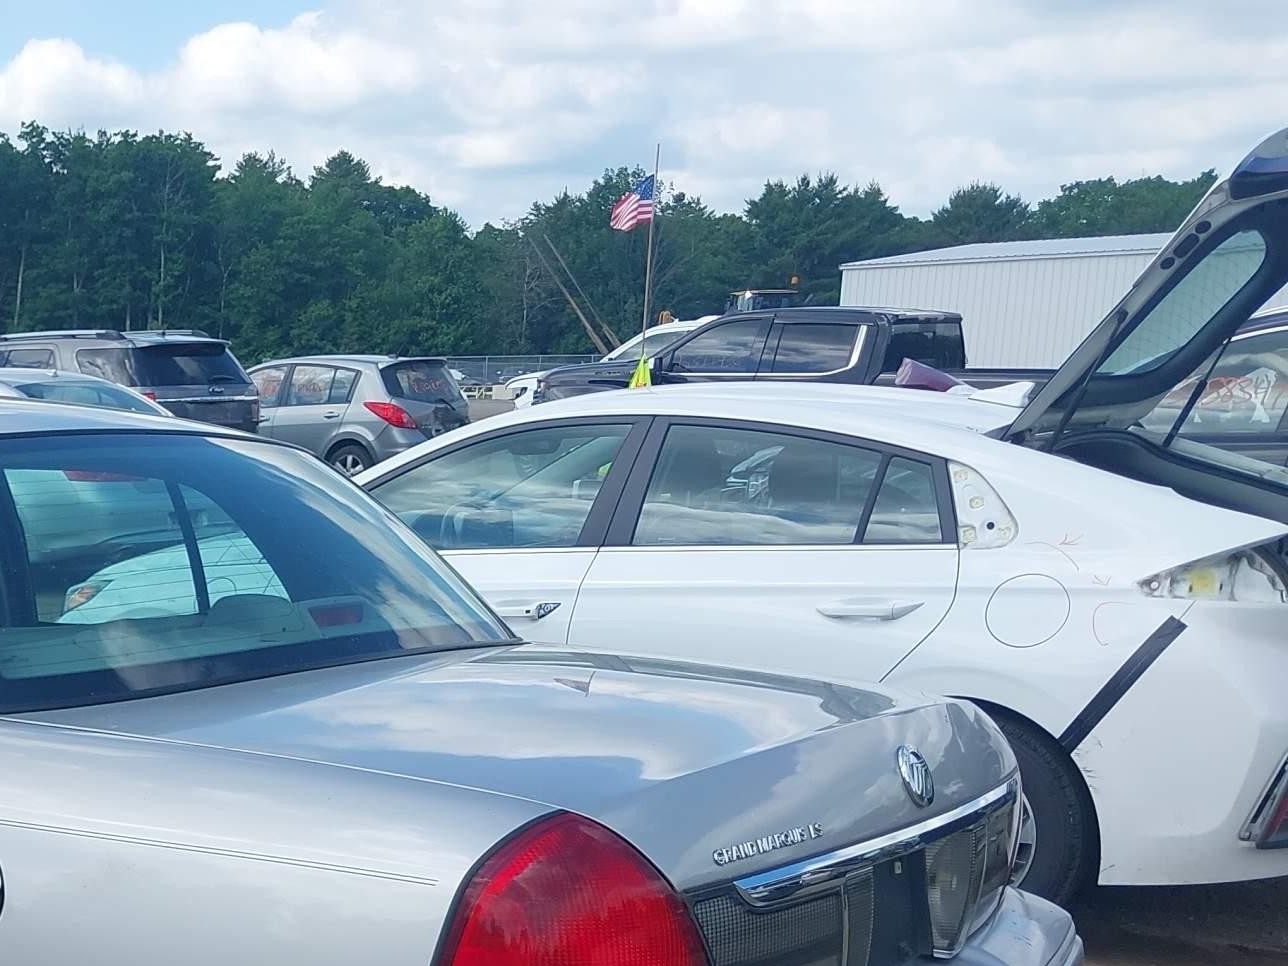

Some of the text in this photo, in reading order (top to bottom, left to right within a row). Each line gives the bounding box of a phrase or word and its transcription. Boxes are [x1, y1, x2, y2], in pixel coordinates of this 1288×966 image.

[713, 823, 824, 865] GRAND MARQUIS LS
